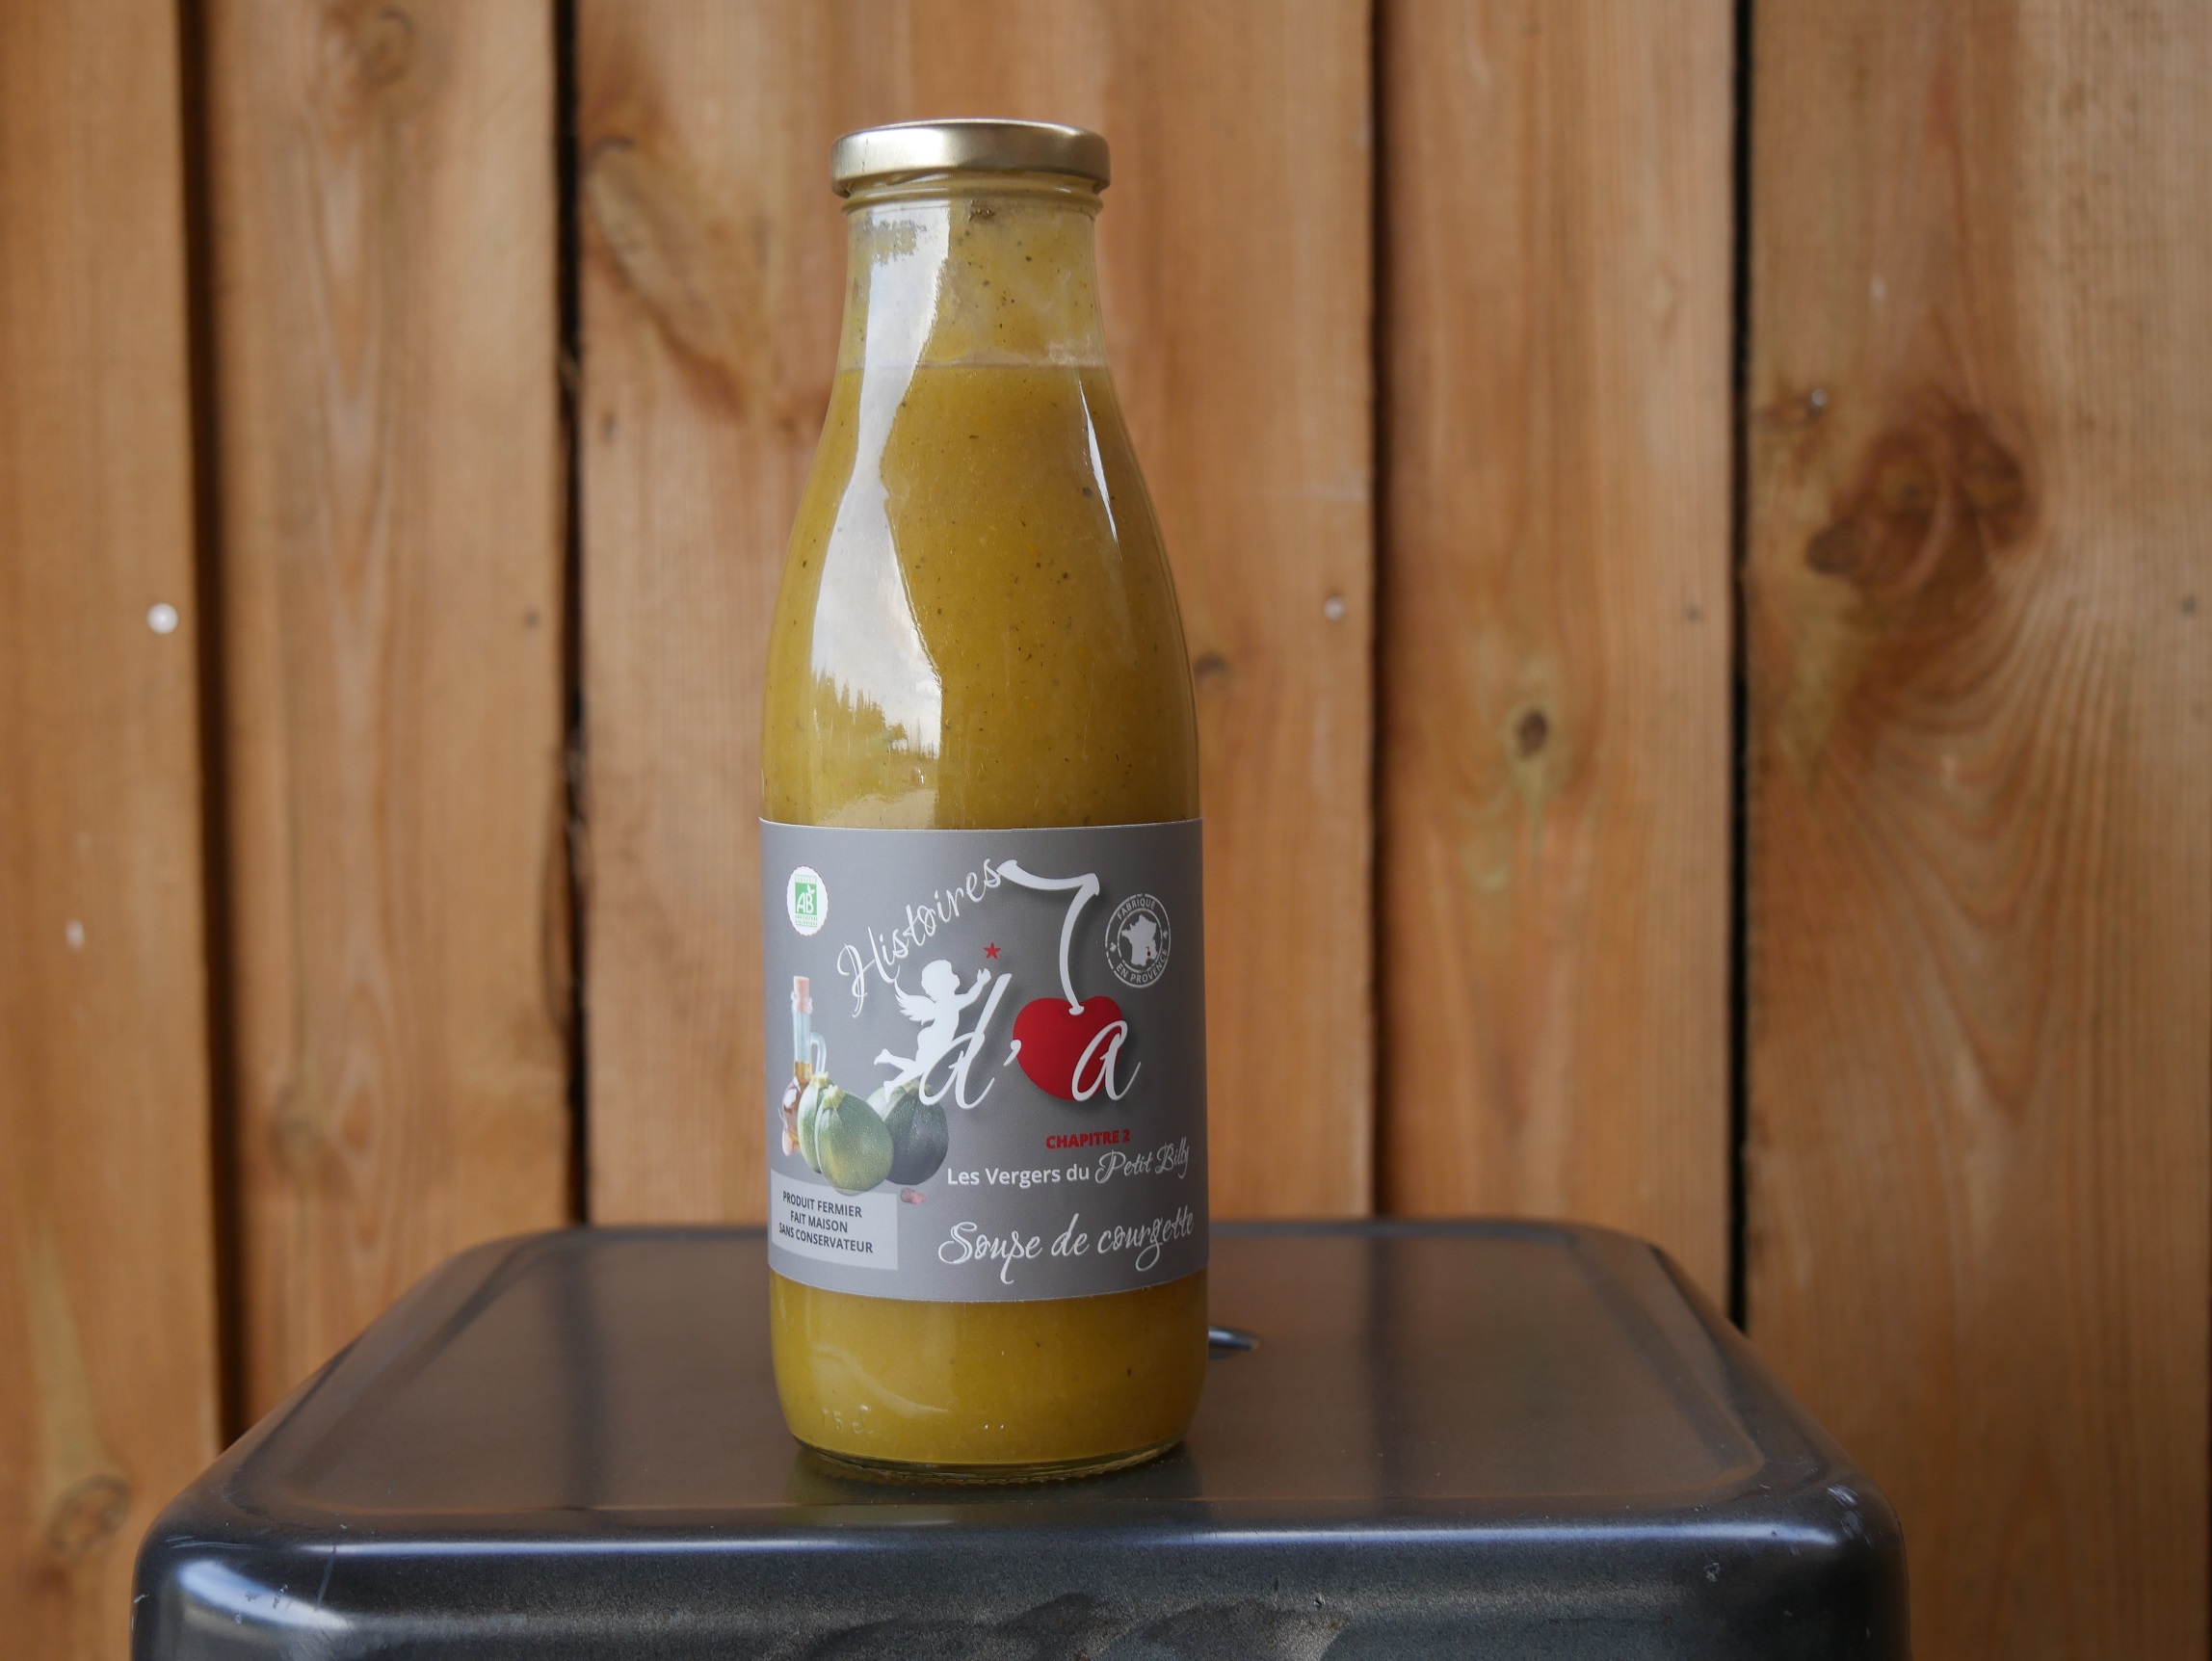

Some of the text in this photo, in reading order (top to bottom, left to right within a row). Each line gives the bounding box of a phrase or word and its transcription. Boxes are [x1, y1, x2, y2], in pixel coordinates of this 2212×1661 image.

[797, 891, 814, 914] AB
[837, 858, 1001, 1018] Histoires
[1117, 948, 1168, 983] EN PROVENCE
[1045, 1128, 1131, 1149] CHAPITRE 2
[947, 1136, 1190, 1190] Les Vergers du Petit Billy
[782, 1190, 862, 1218] PRODUIT FERMIER
[790, 1210, 848, 1233] FAIT MAISON
[778, 1223, 874, 1253] SANS CONSERVATEUR
[937, 1204, 1195, 1285] Soupe de courgette
